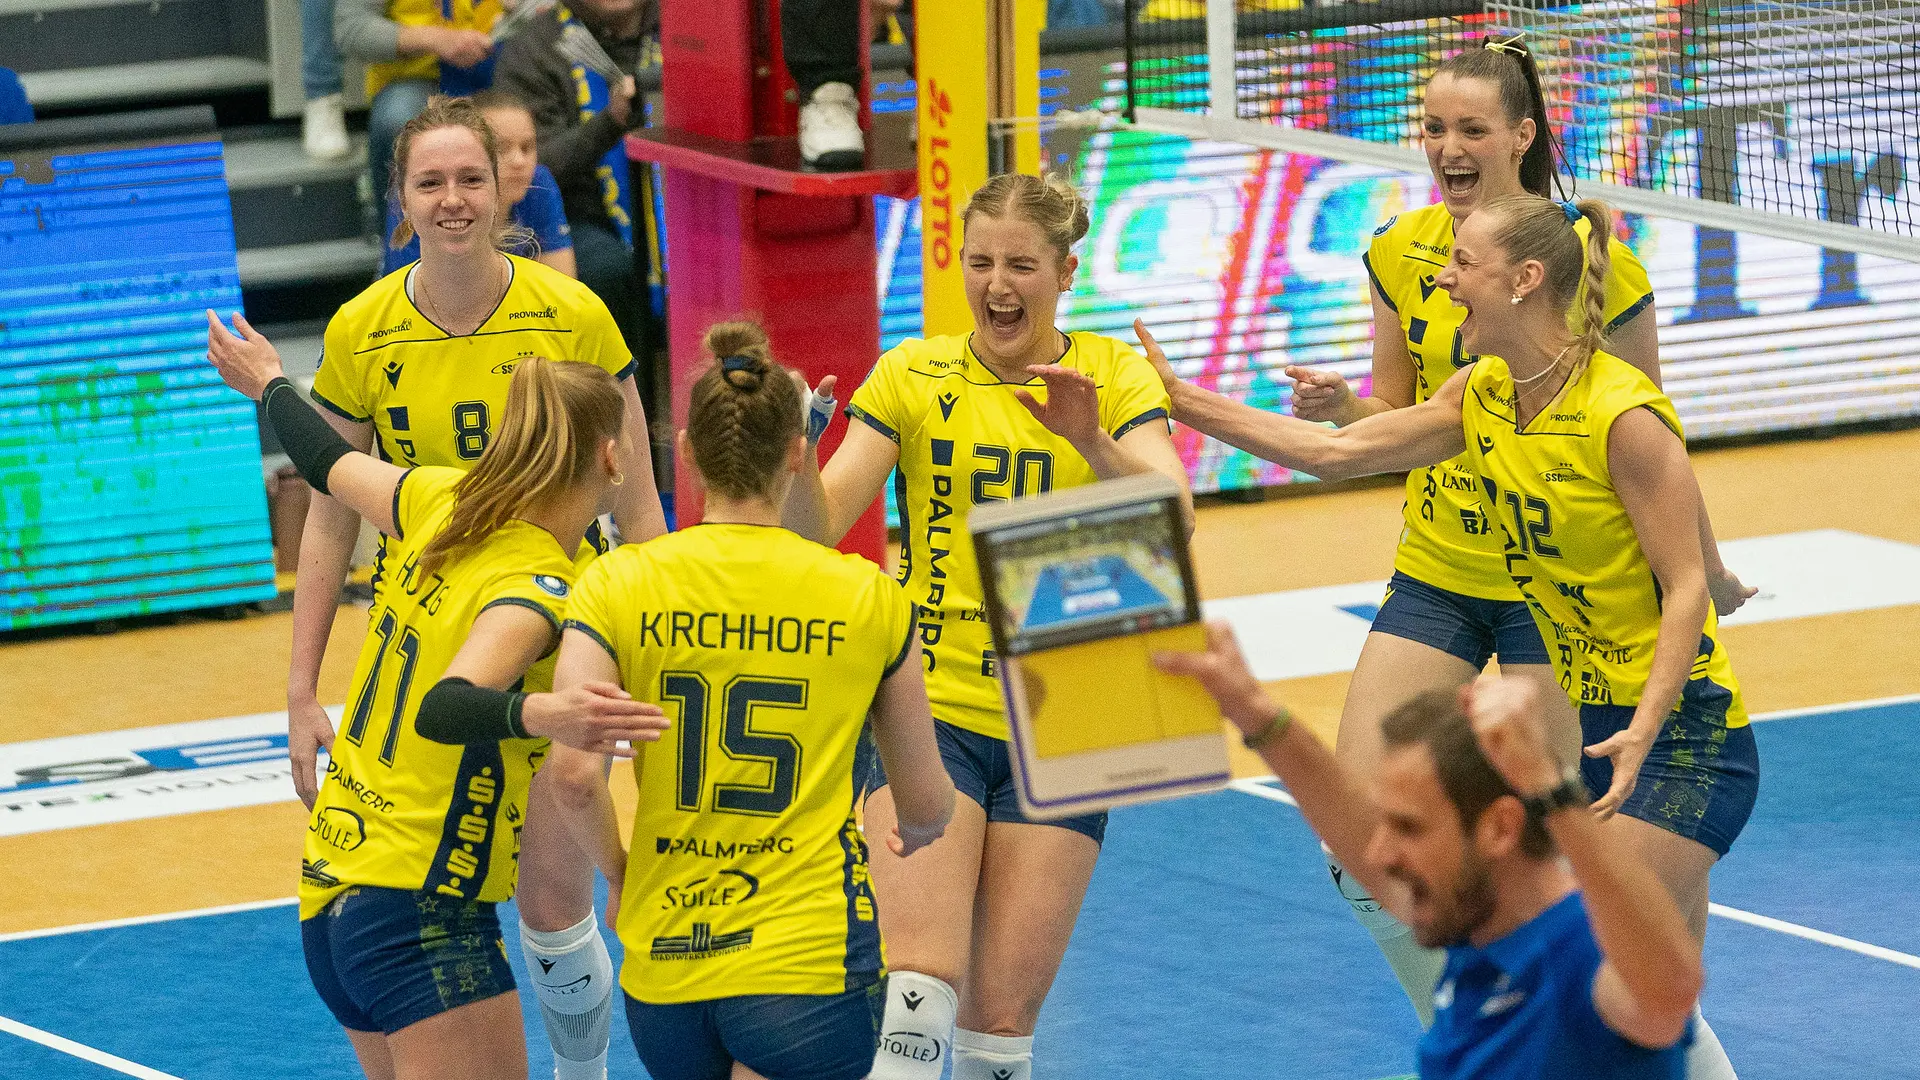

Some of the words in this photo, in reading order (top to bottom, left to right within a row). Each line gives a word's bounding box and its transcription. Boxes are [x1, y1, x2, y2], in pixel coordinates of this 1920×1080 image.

[930, 136, 952, 270] LOTTO
[508, 309, 556, 320] PROVINZIAL
[452, 399, 491, 461] 8
[971, 442, 1055, 508] 20
[1503, 490, 1563, 560] 12
[640, 611, 846, 656] KIRCHHOFF
[345, 605, 421, 768] 11
[660, 669, 809, 819] 15
